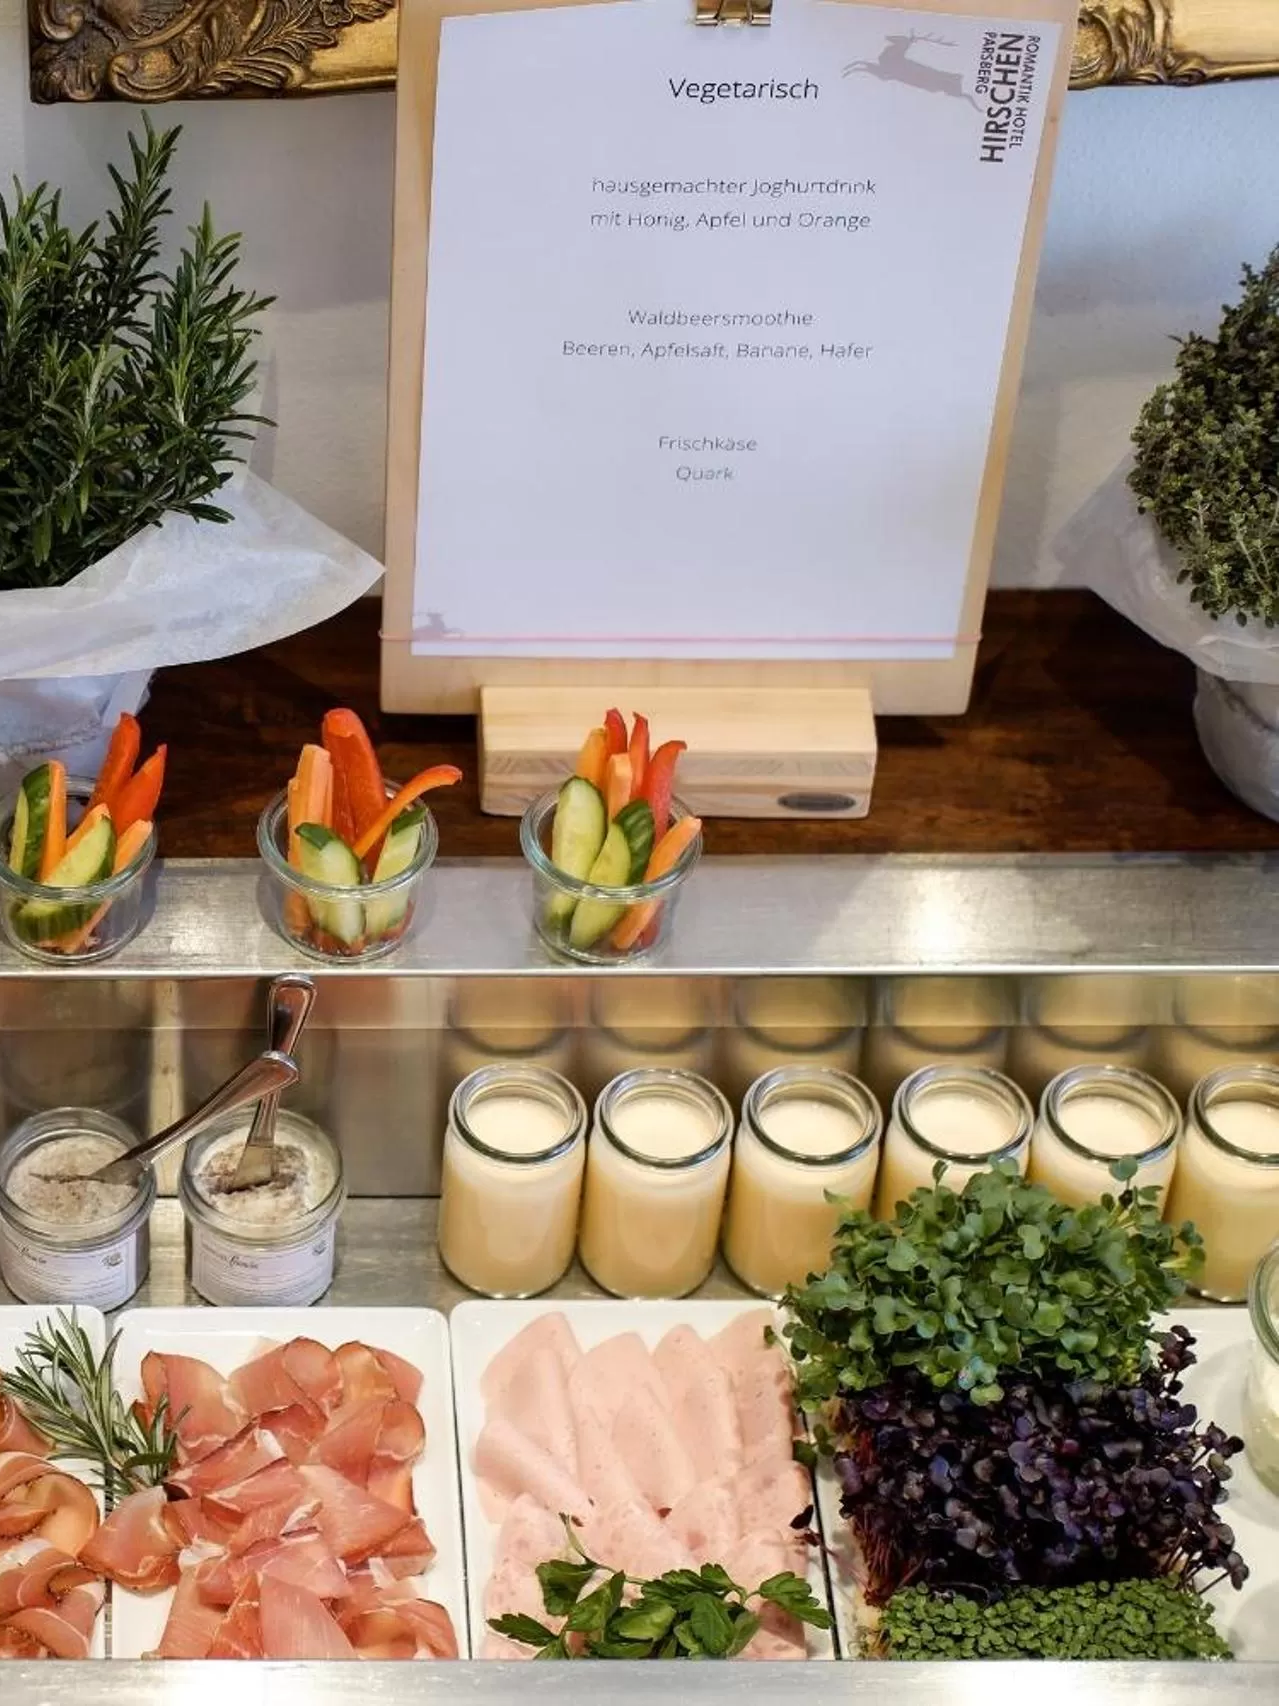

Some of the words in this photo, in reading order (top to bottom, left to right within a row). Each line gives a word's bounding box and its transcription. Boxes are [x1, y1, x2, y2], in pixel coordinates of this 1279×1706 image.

[975, 31, 997, 95] PARSBERG
[1017, 35, 1041, 103] ROMANTIK
[668, 76, 821, 105] Vegetarisch
[980, 33, 1025, 163] HIRSCHEN
[1008, 107, 1028, 149] HOTEL
[591, 176, 748, 199] hausgemachter
[749, 179, 877, 198] Joghurtdrink
[589, 209, 623, 229] mit
[627, 211, 690, 233] Honig,
[695, 211, 748, 232] Apfel
[753, 210, 792, 230] und
[797, 211, 872, 233] Orange
[627, 308, 814, 328] Waldbeersmoothie
[561, 339, 636, 361] Beeren,
[640, 340, 730, 362] Apfelsaft,
[735, 342, 814, 362] Banane,
[819, 342, 874, 361] Hafer
[658, 435, 759, 454] Frischkäse
[675, 464, 735, 484] Quark
